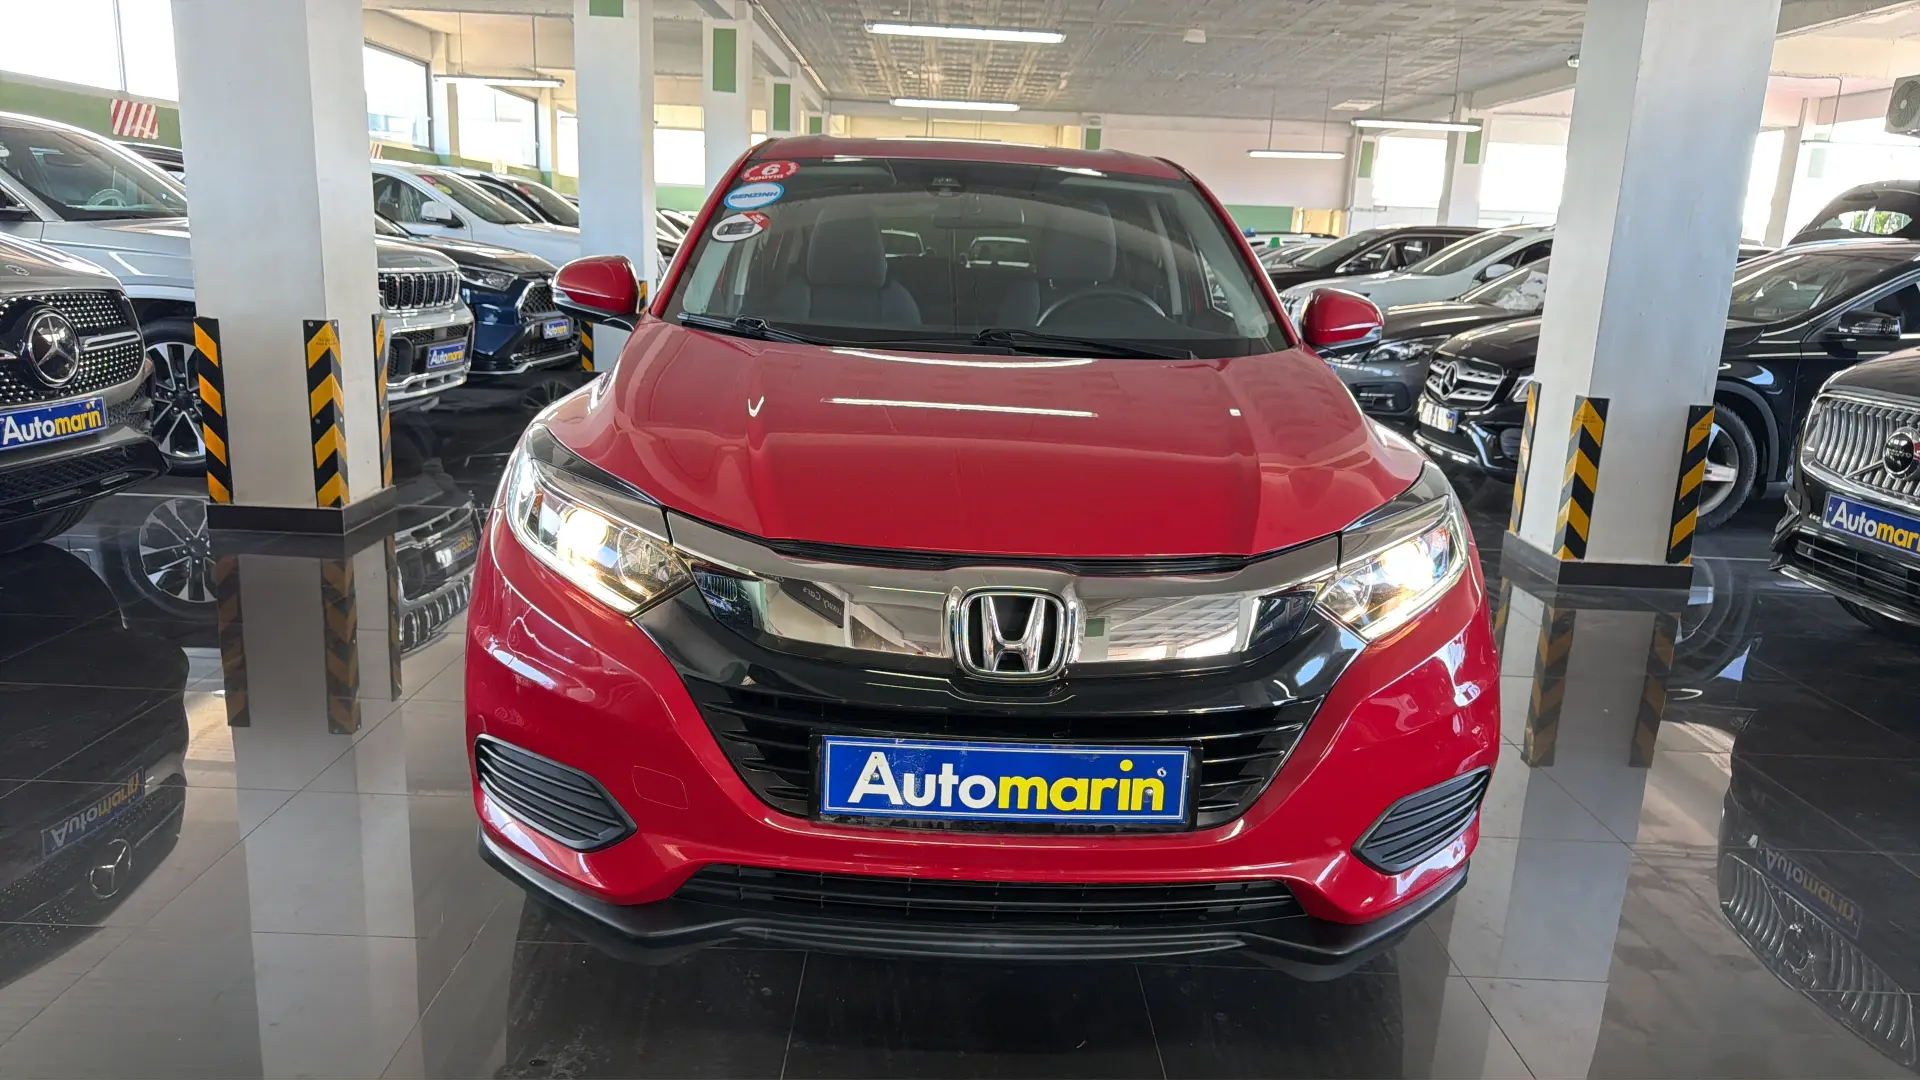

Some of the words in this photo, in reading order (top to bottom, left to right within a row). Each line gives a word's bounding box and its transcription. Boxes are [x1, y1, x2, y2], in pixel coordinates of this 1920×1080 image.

[761, 163, 781, 175] 6
[3, 403, 102, 445] Automarin
[847, 751, 1165, 811] Automarin
